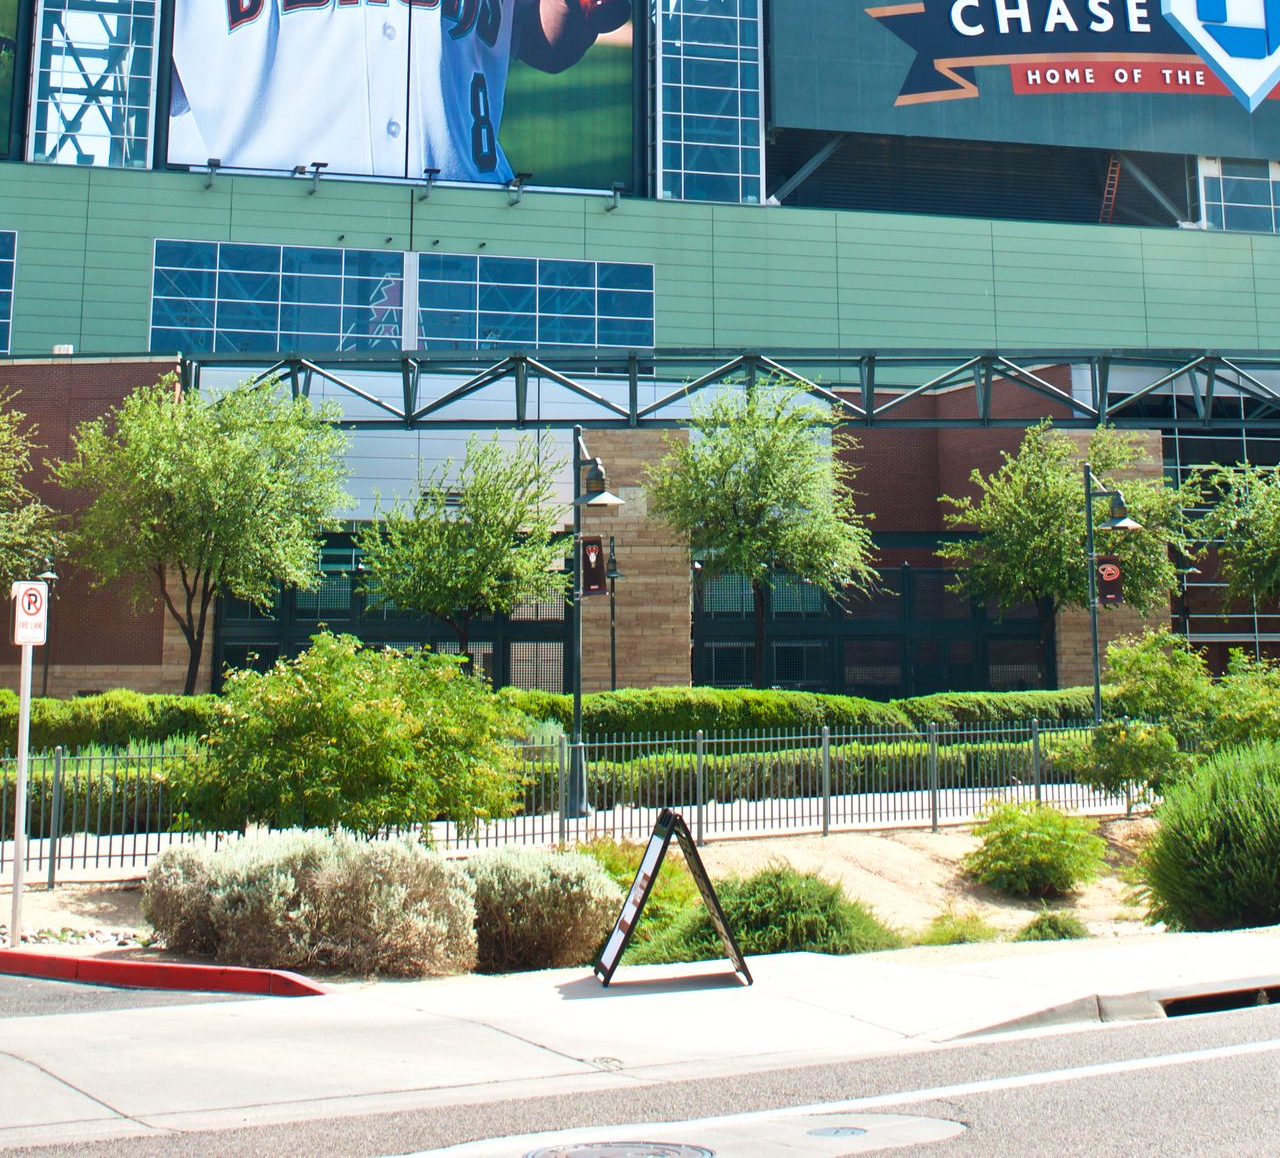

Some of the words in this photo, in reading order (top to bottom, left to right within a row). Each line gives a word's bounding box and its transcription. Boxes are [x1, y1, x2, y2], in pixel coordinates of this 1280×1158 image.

[1026, 68, 1095, 86] HOME
[1114, 68, 1143, 84] OF
[1162, 68, 1206, 87] THE
